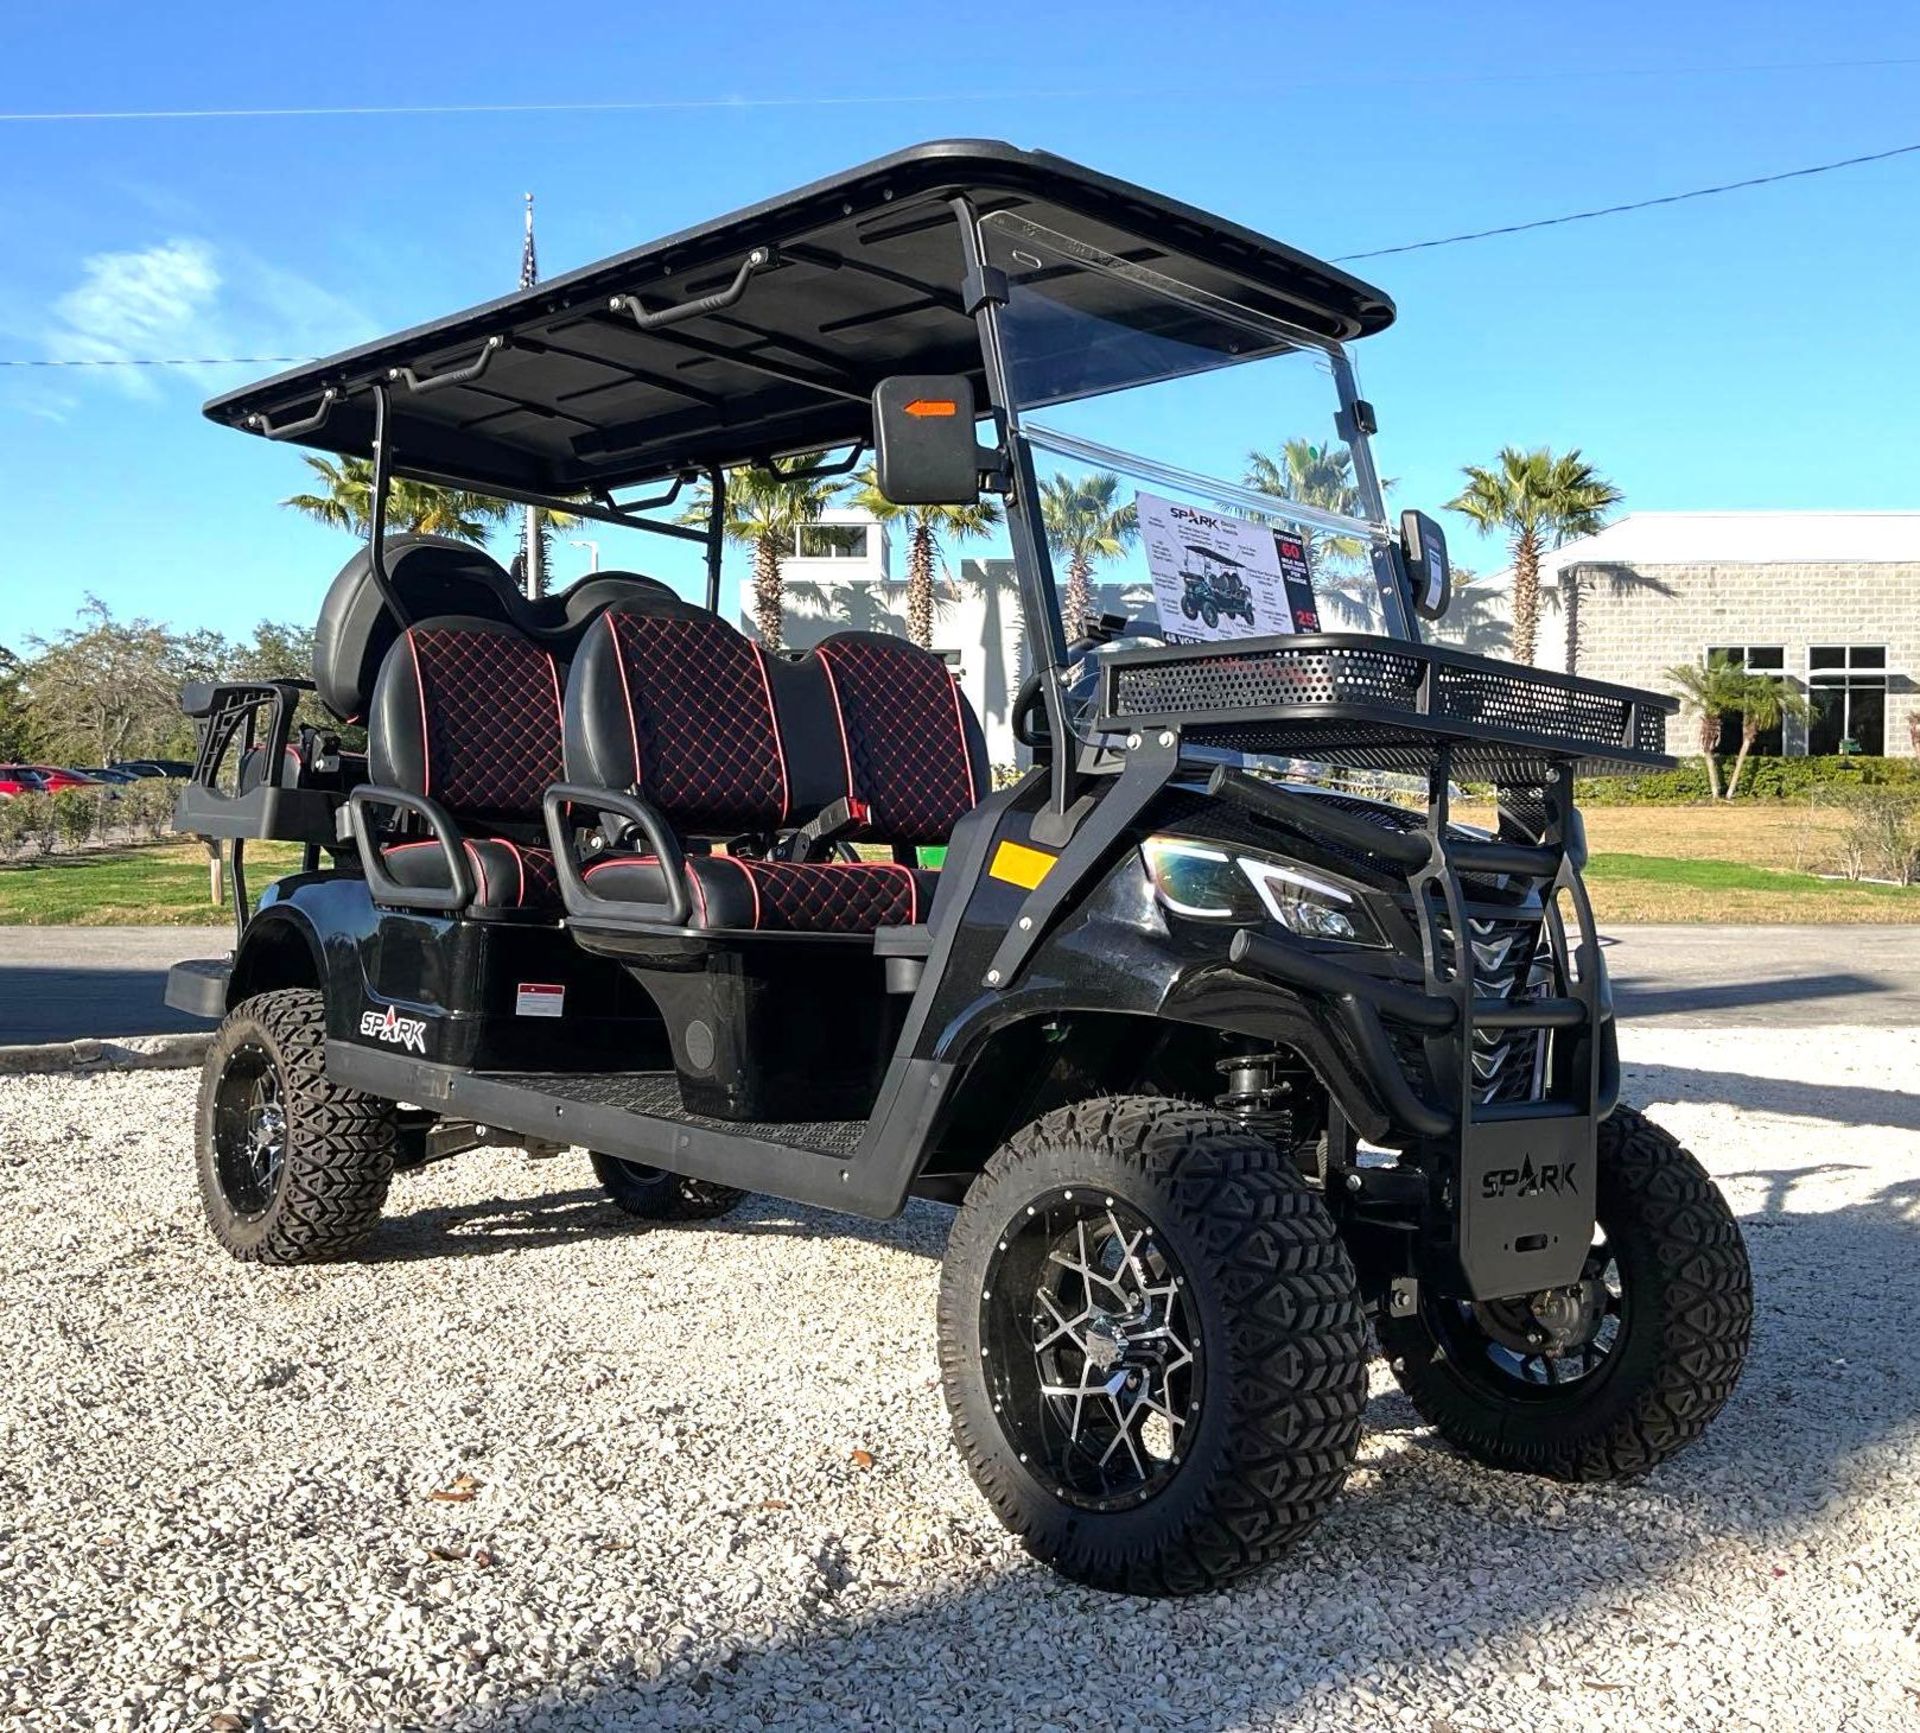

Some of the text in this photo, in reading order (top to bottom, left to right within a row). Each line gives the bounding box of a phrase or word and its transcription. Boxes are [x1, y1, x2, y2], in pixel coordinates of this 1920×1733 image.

[1170, 507, 1221, 531] SPARK
[1281, 541, 1300, 560] 60
[1296, 610, 1313, 627] 25
[360, 1005, 427, 1055] SPARK
[1482, 1152, 1579, 1199] SPARK
